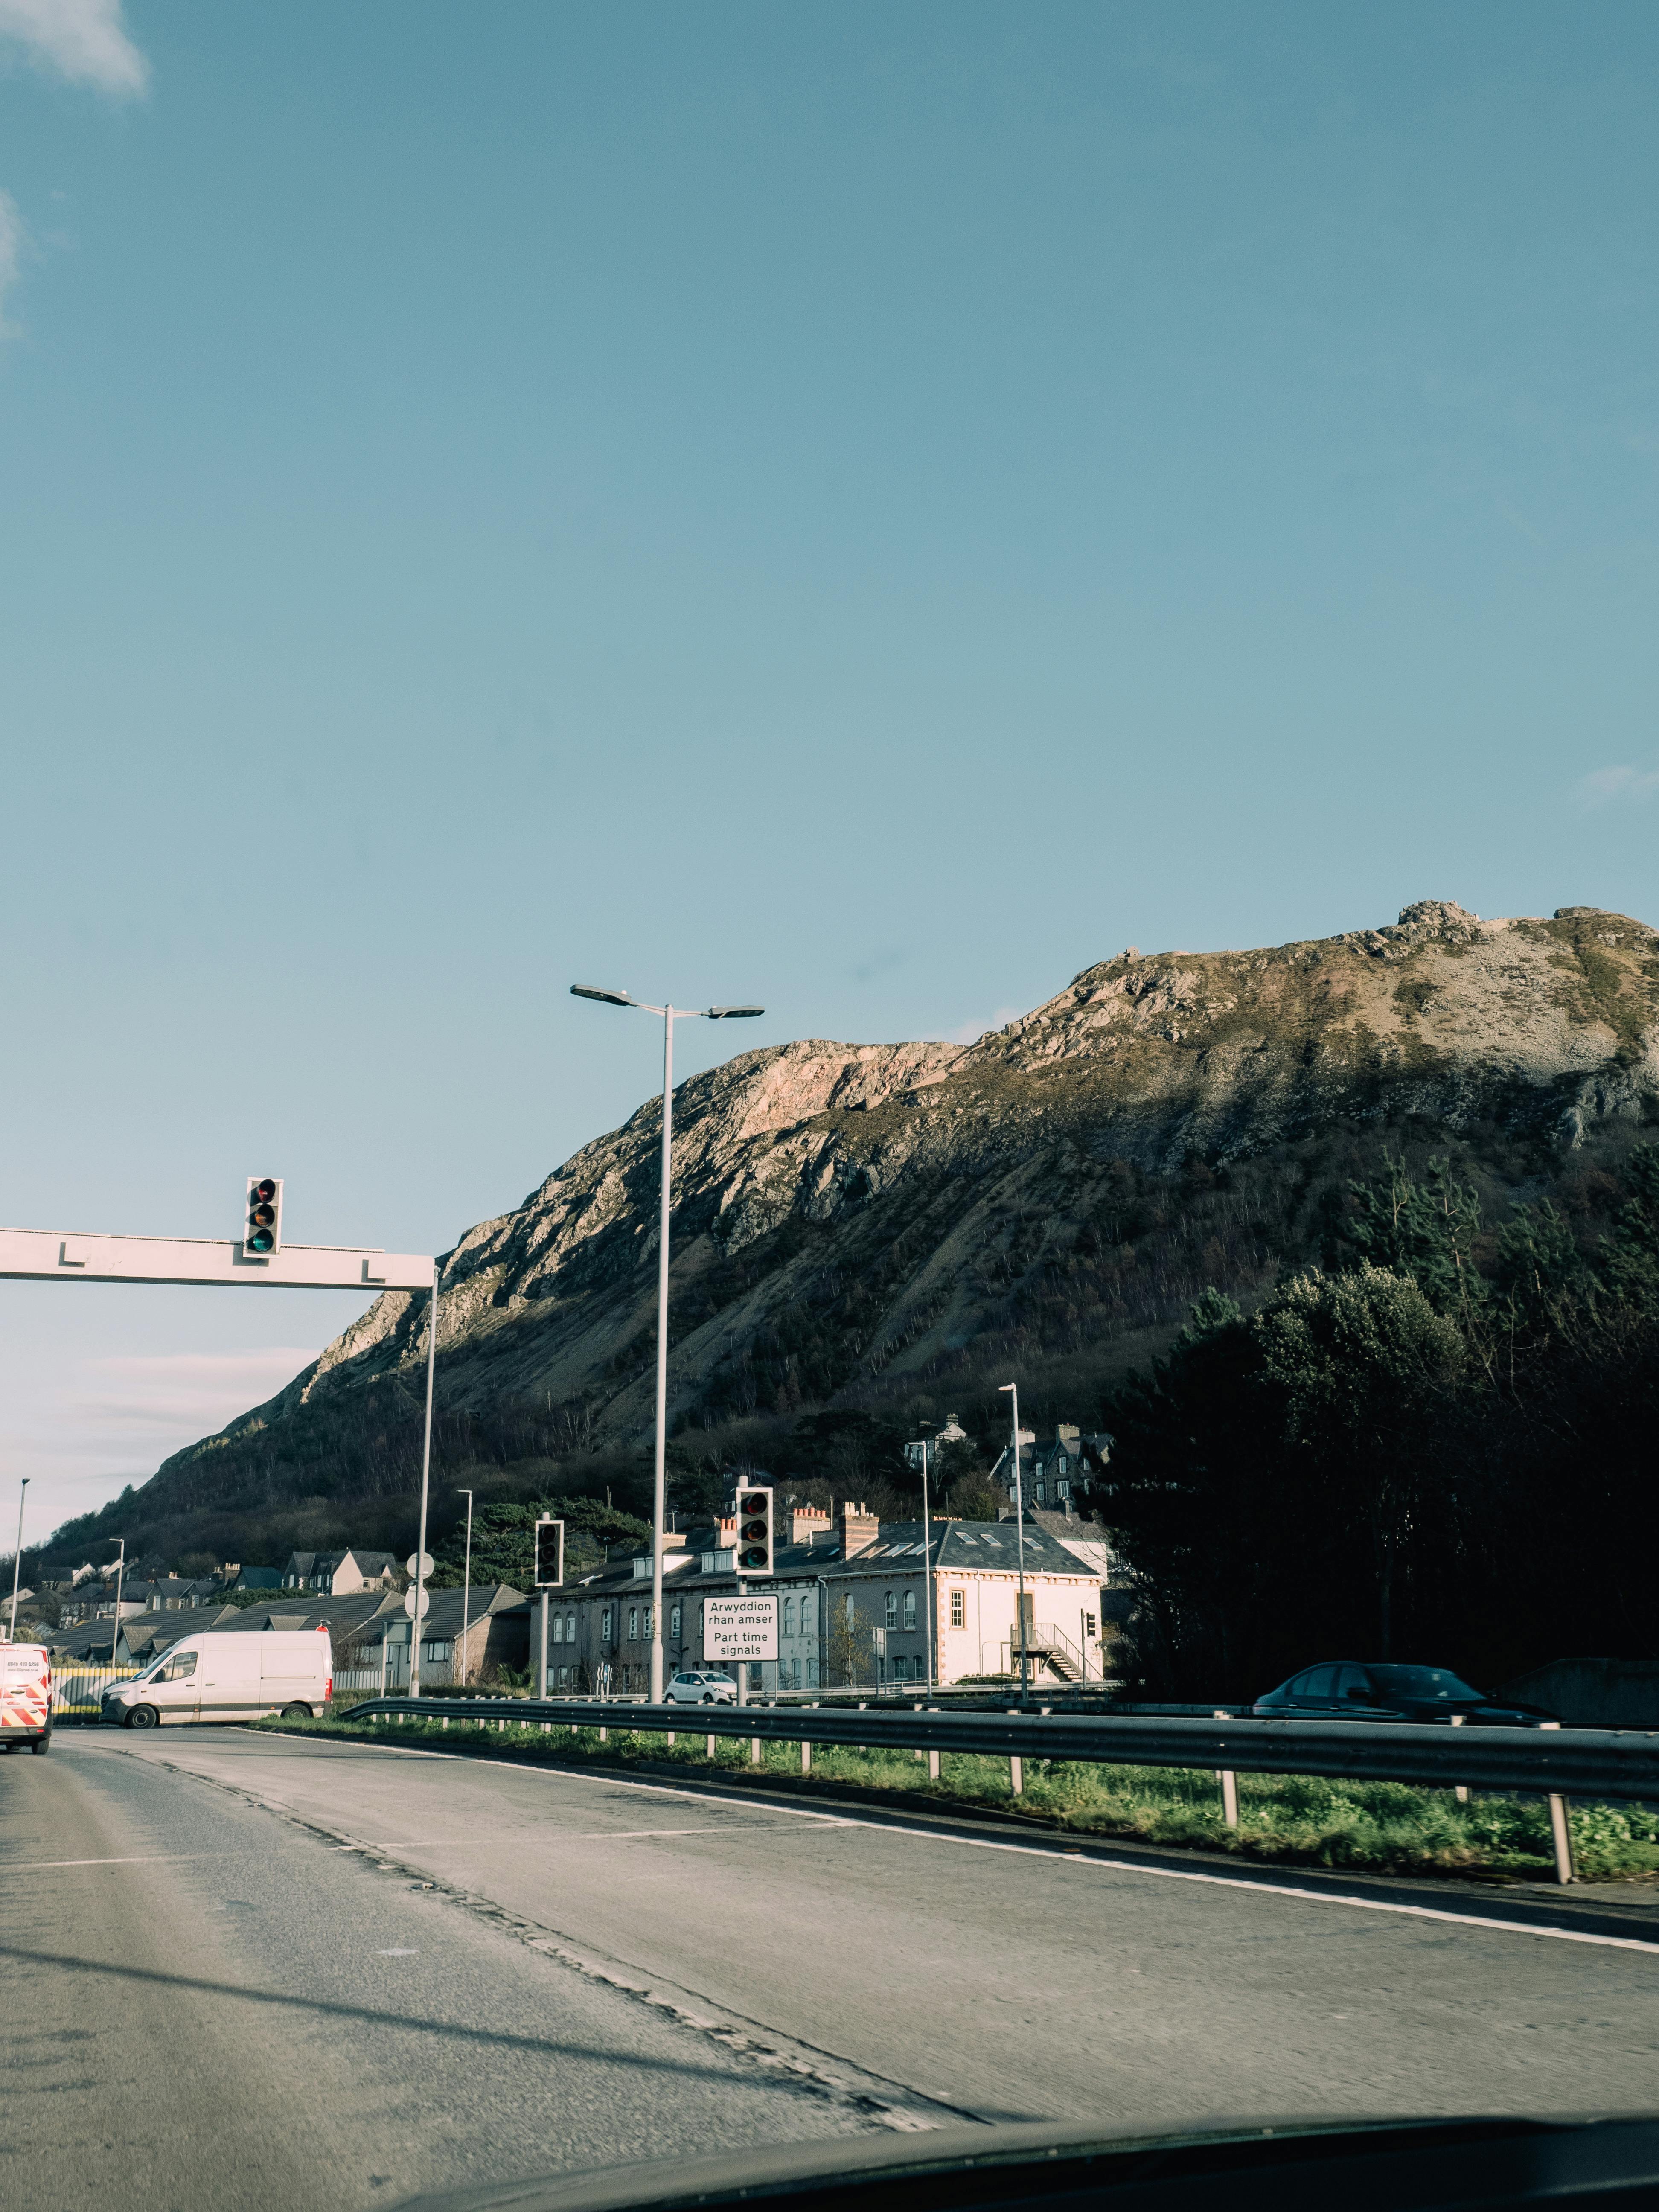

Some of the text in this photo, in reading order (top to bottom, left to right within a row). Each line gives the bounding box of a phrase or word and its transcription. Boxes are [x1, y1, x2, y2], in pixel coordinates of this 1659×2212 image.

[710, 1601, 771, 1613] Arwyddion
[709, 1615, 733, 1624] rhan
[714, 1632, 768, 1642] Part time
[721, 1645, 761, 1656] signals
